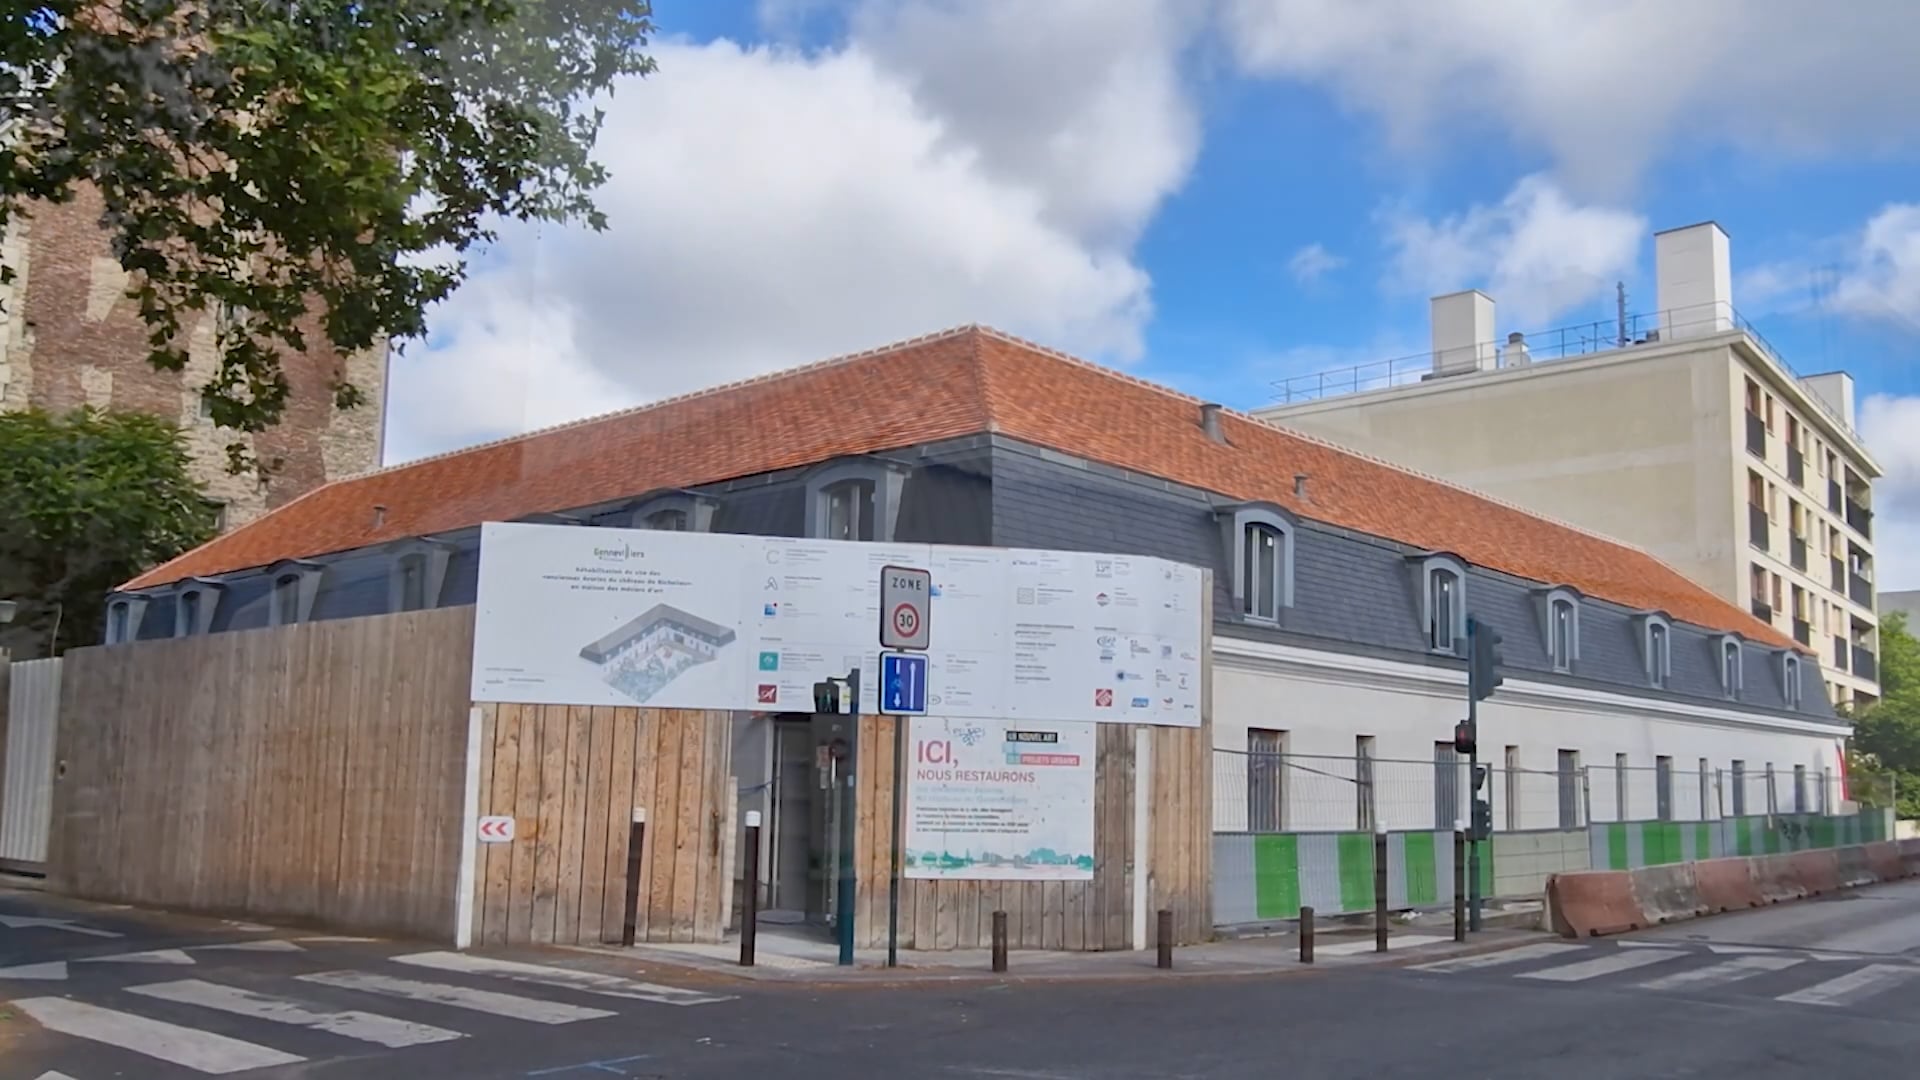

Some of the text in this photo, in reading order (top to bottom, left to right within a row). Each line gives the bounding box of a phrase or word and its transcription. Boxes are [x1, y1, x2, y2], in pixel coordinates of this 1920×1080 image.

[892, 577, 922, 591] ZONE
[899, 614, 914, 628] 30
[918, 740, 959, 768] ICI,
[917, 769, 1036, 783] NOUS RESTAURONS
